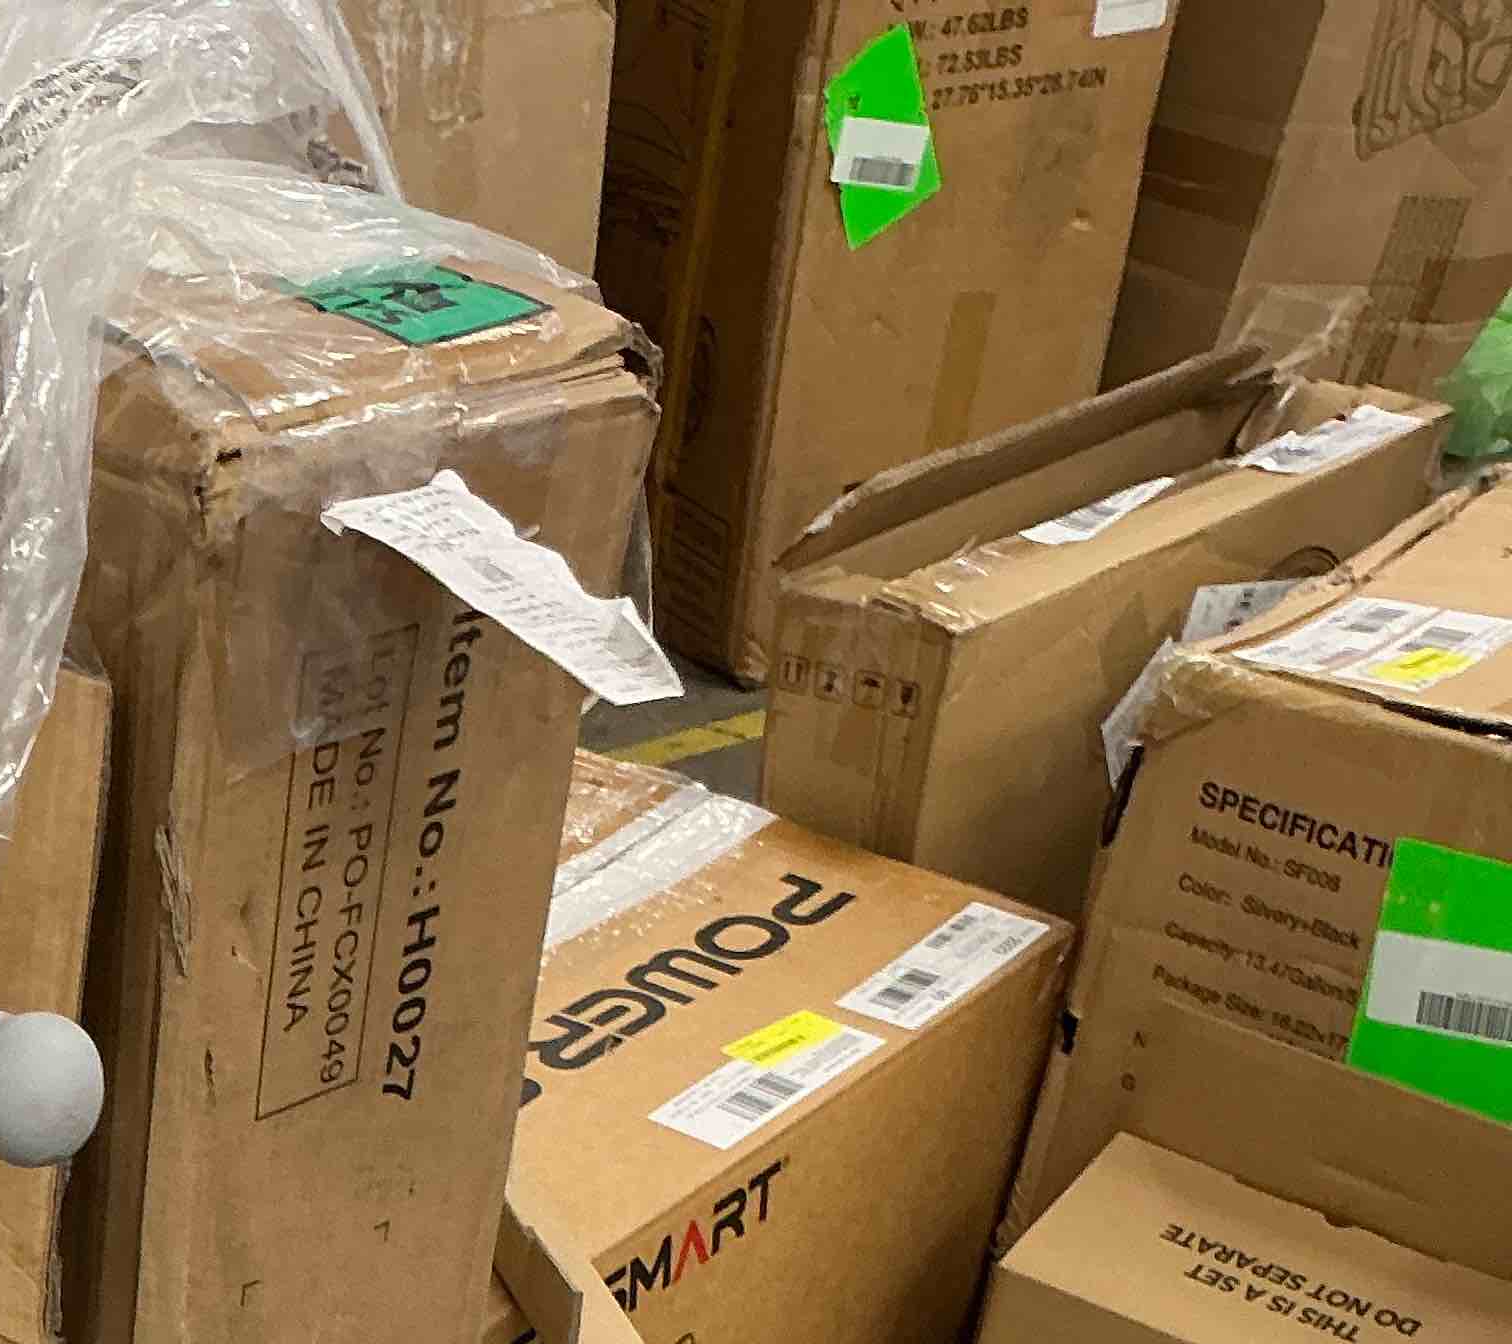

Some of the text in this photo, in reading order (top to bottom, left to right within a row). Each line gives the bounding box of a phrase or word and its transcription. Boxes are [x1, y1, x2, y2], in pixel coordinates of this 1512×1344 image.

[433, 606, 483, 752] Item
[301, 822, 331, 872] IN
[1190, 825, 1241, 861] Model
[1199, 781, 1394, 869] SPECIFICATI
[1178, 871, 1234, 908] Color:
[282, 885, 324, 1032] CHINA
[319, 822, 374, 1084] PO-FCX0049
[1159, 1223, 1424, 1338] DO NOT SEPARATE
[1183, 1262, 1361, 1344] THIS IS A SET
